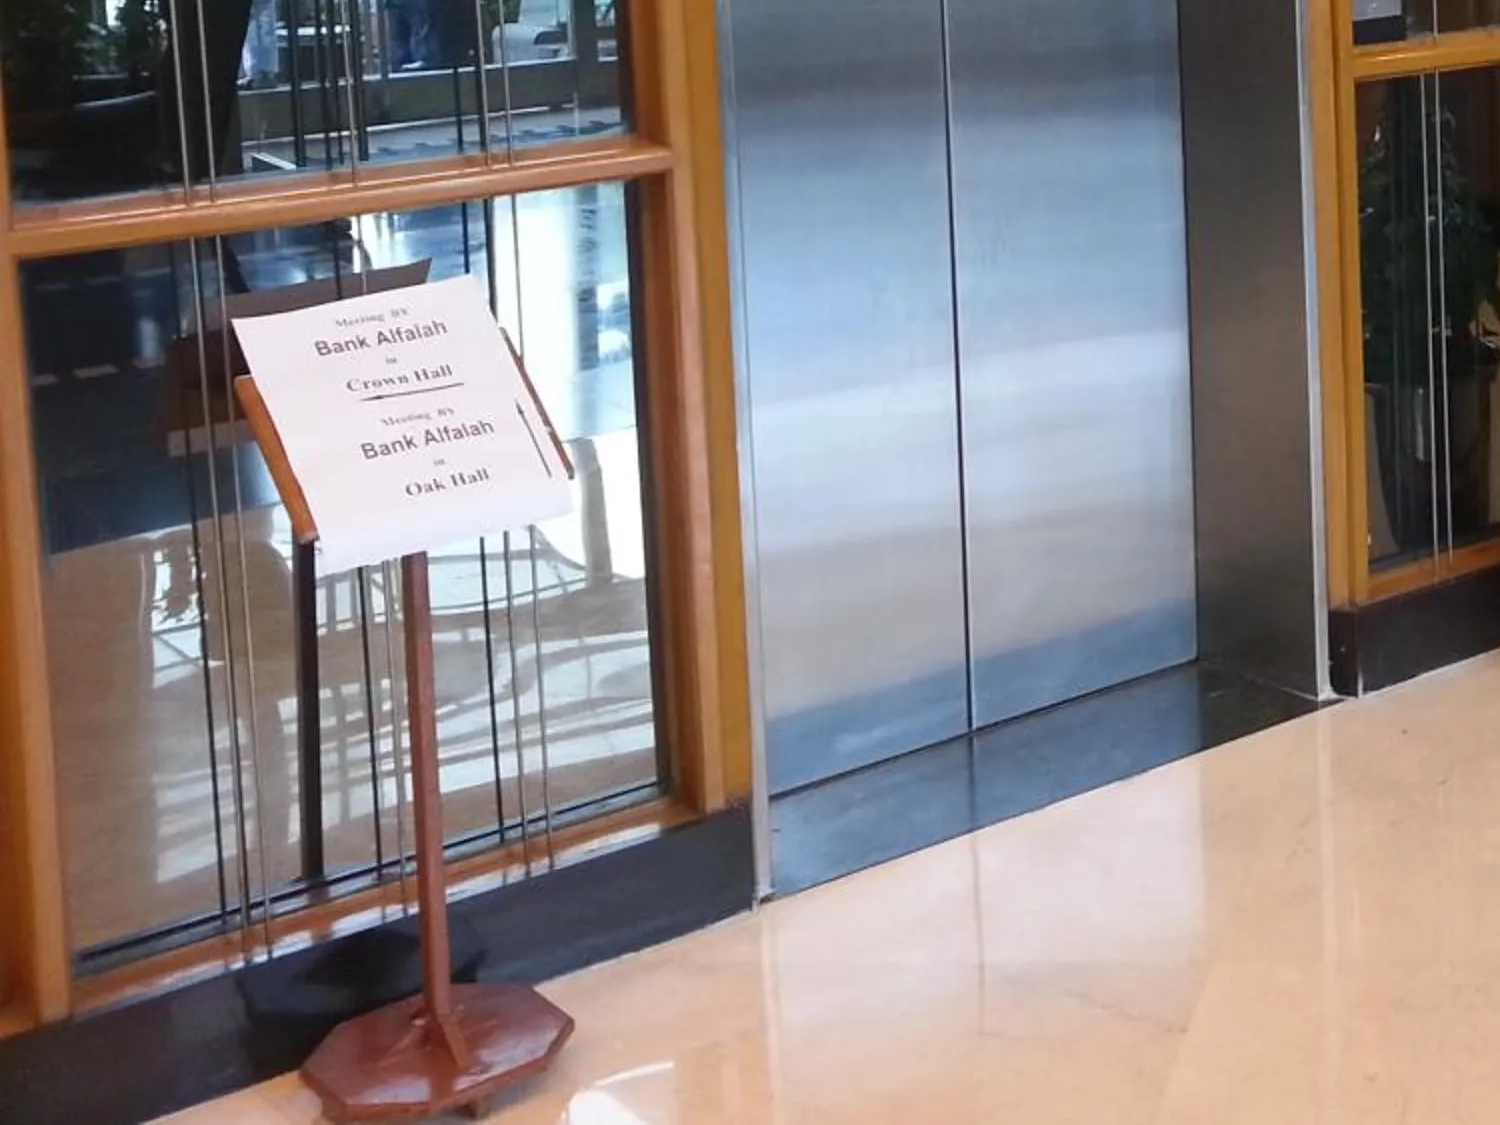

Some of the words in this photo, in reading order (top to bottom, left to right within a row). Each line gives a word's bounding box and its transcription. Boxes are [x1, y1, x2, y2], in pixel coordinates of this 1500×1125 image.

[335, 313, 385, 328] Meeting
[314, 335, 371, 357] Bank
[377, 320, 448, 346] Alfalah
[346, 376, 409, 392] Crown
[414, 364, 453, 382] Hall
[361, 435, 418, 460] Bank
[424, 420, 495, 446] Alfalah
[405, 478, 447, 496] Oak
[450, 468, 490, 487] Hall
